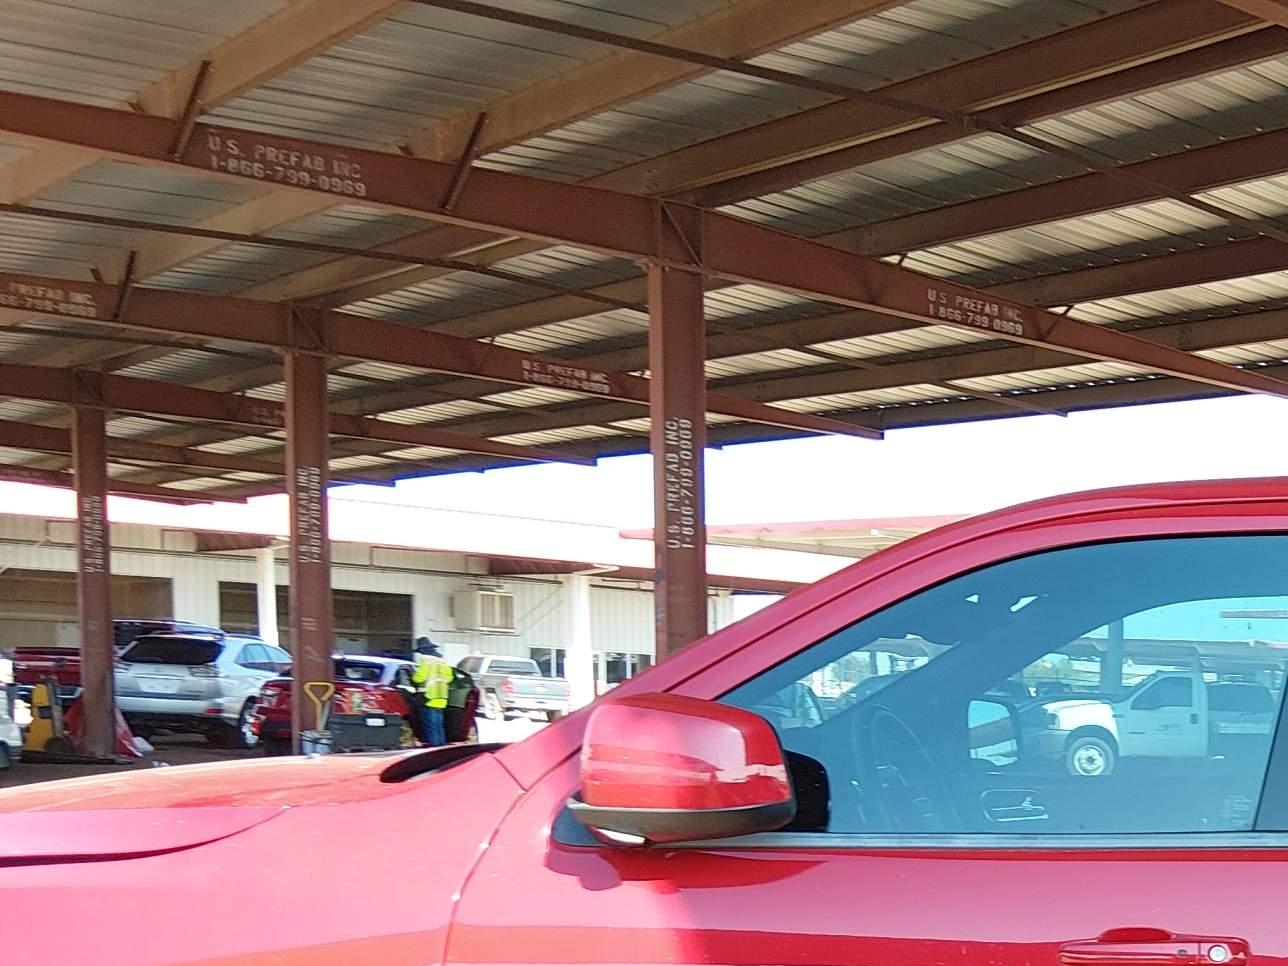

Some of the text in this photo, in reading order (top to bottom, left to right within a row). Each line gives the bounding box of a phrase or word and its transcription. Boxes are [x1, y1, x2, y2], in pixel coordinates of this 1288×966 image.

[254, 144, 325, 171] PREFAB
[210, 155, 367, 197] 1-866-799-0969
[955, 296, 999, 316] PREFAB
